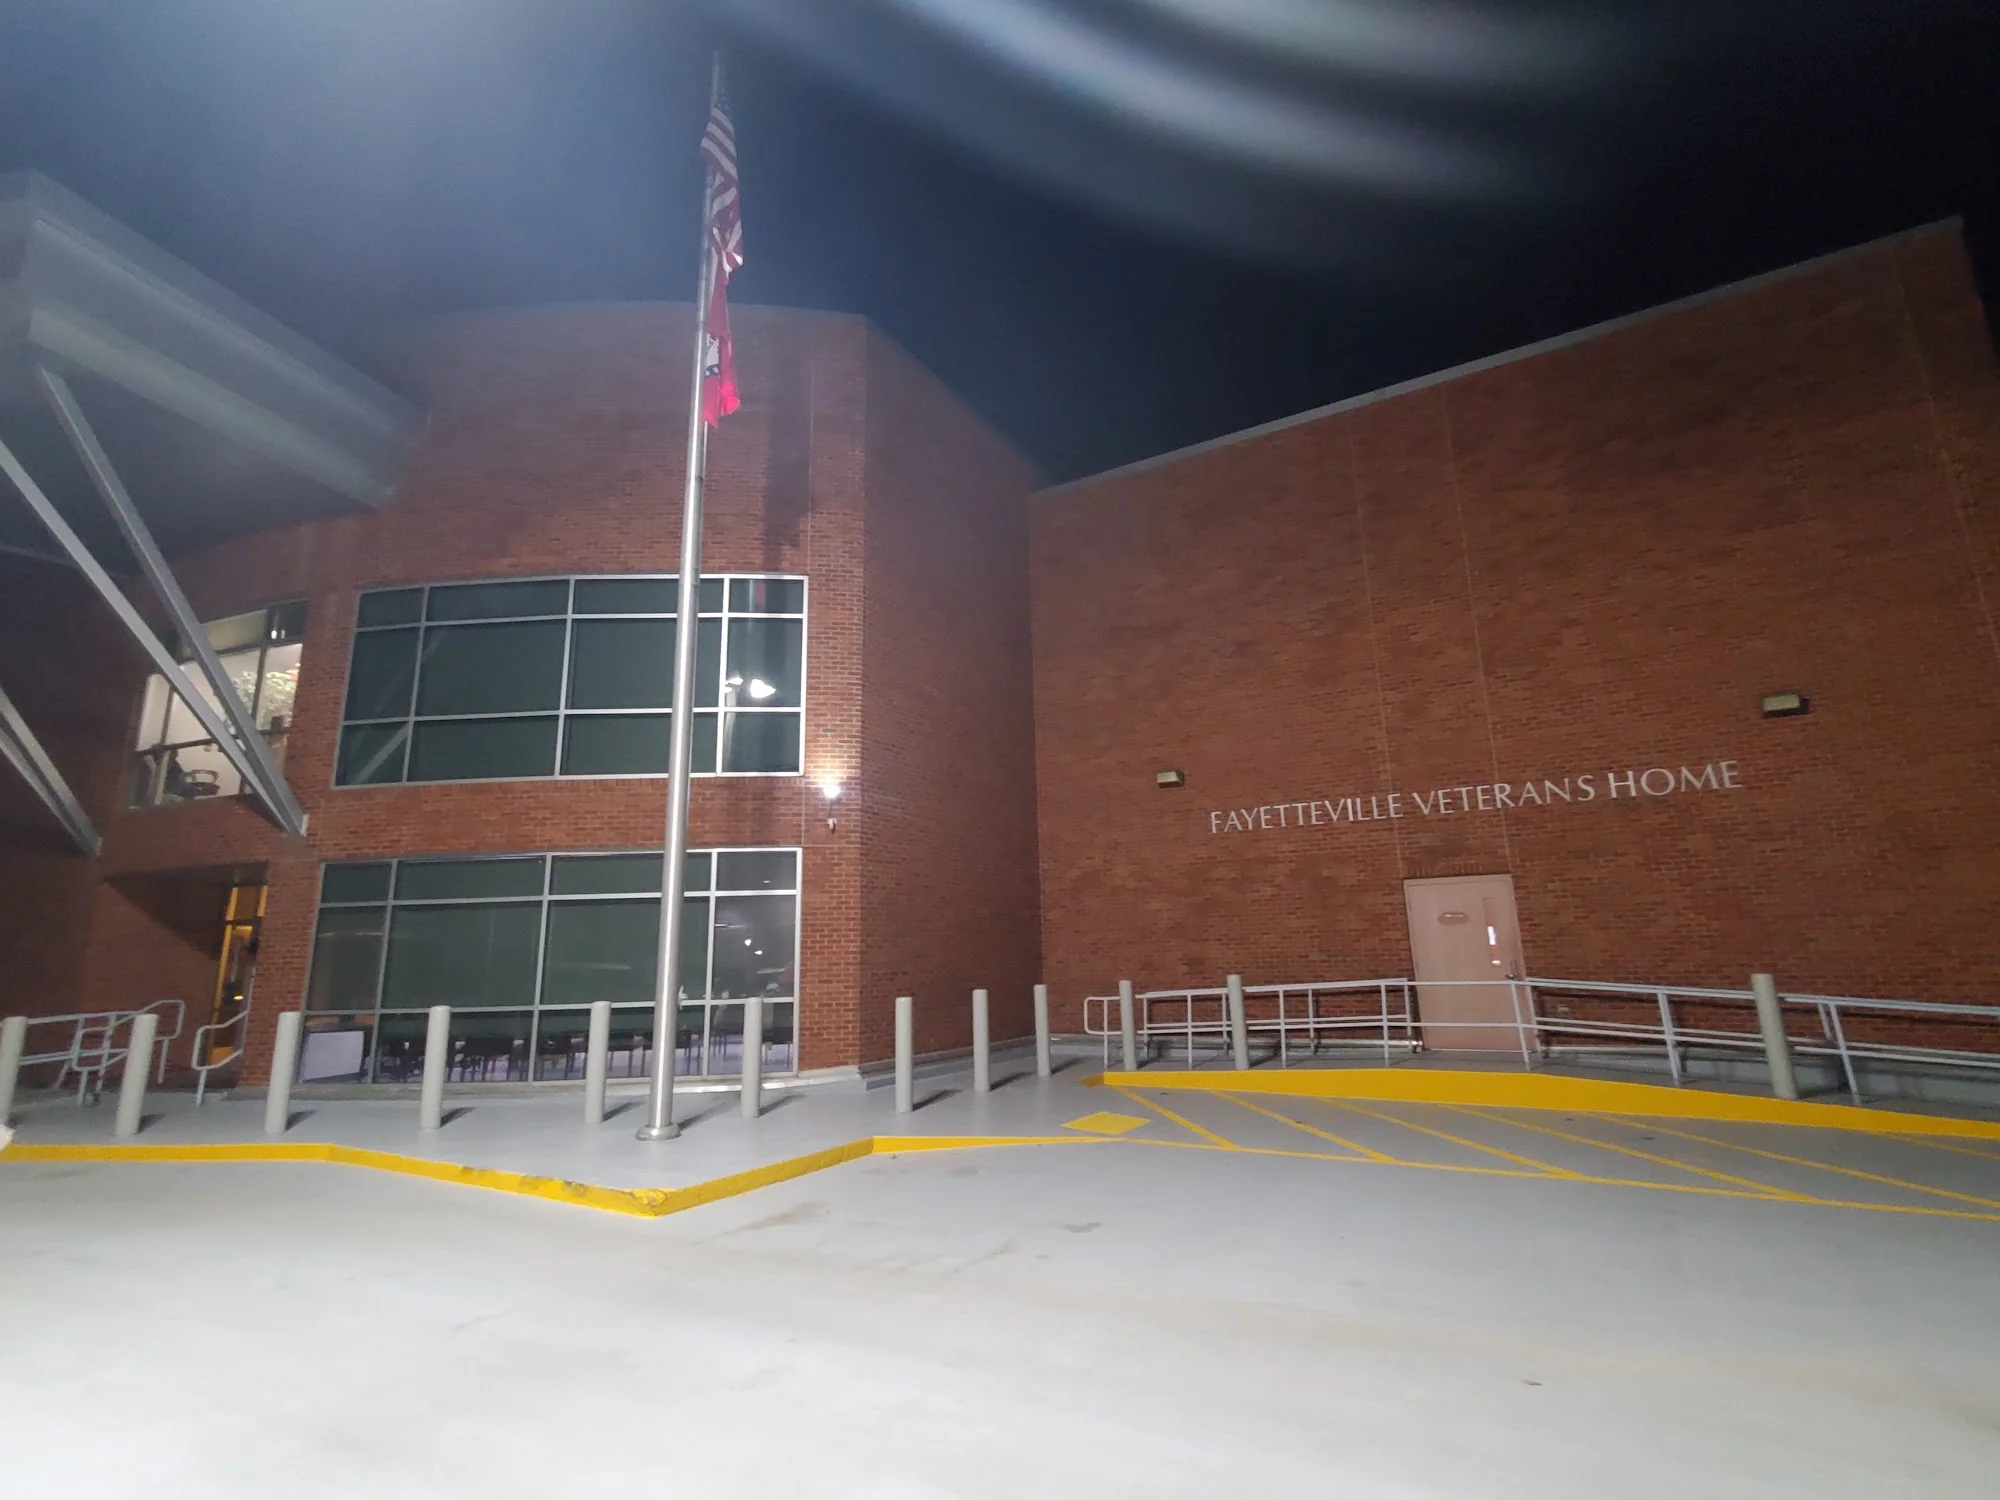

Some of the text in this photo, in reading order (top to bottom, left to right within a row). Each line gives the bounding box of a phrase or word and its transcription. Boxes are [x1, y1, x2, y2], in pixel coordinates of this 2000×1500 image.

[1211, 761, 1742, 833] FAYETTEVILLE VETERANS HOME
